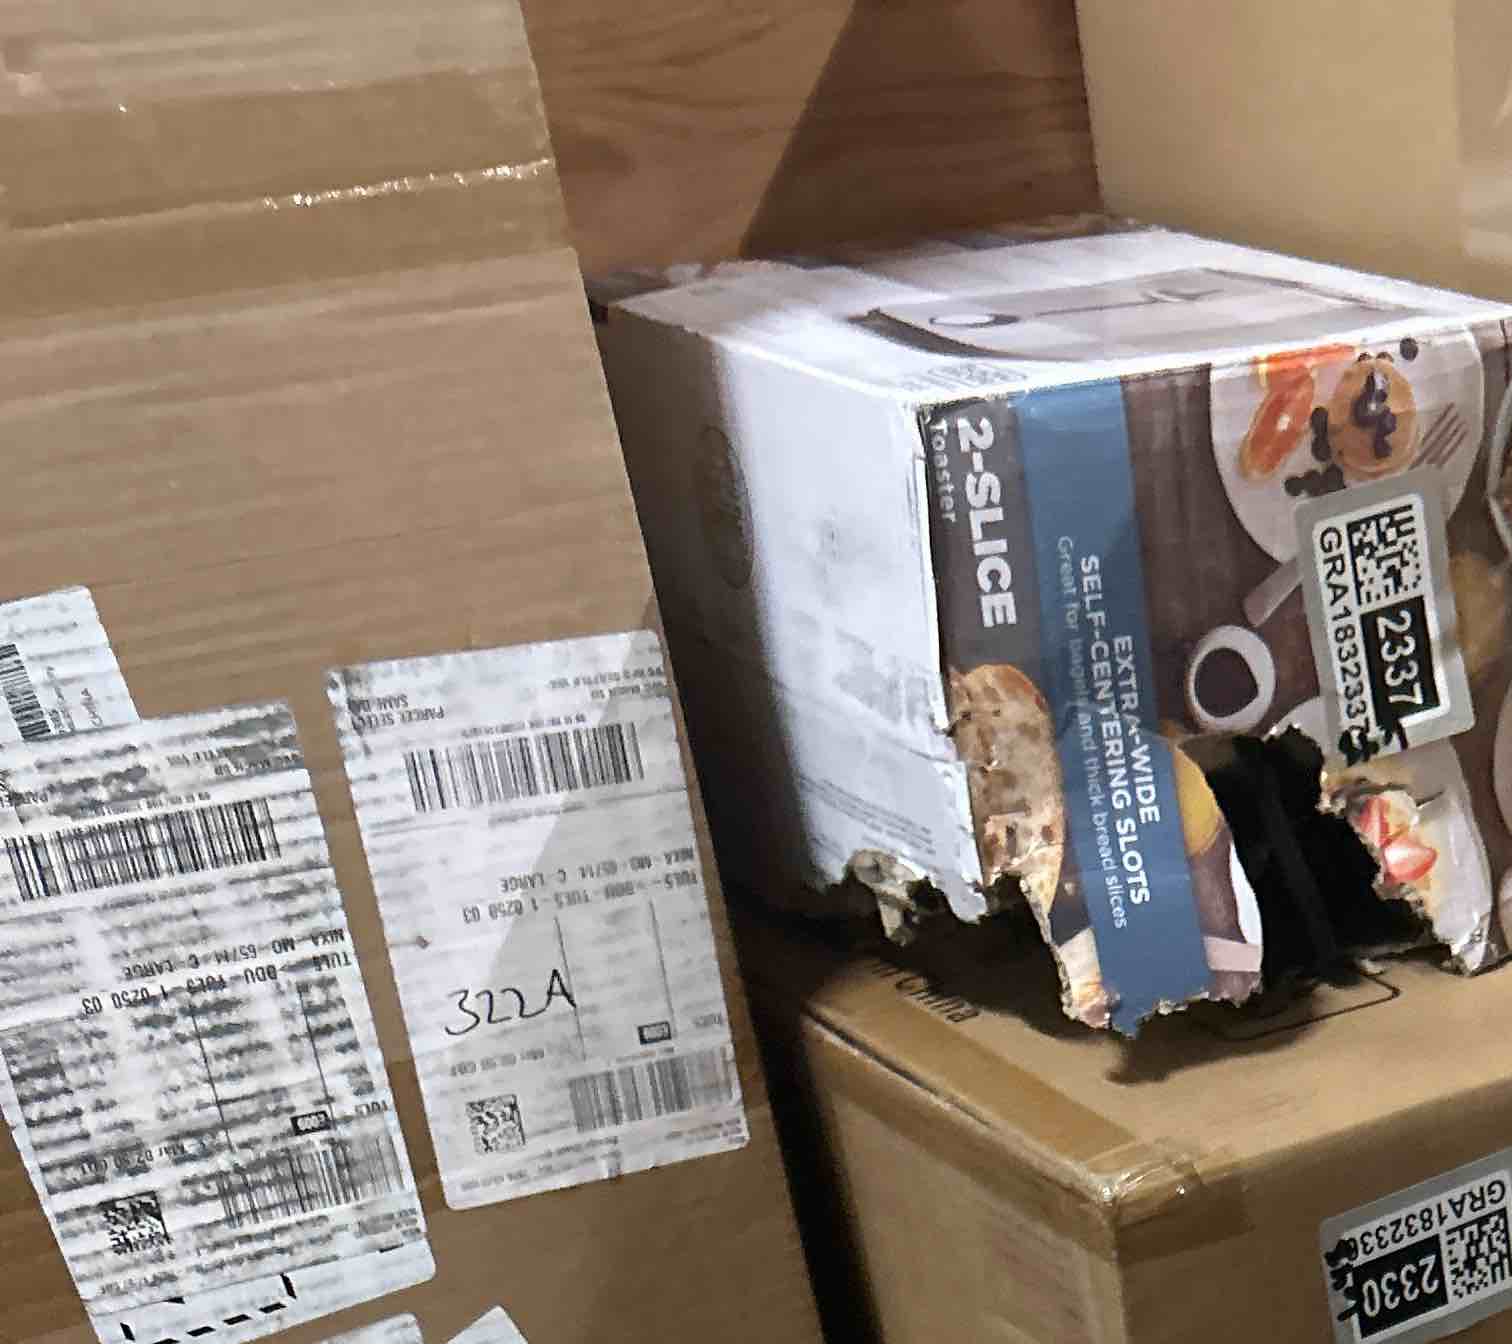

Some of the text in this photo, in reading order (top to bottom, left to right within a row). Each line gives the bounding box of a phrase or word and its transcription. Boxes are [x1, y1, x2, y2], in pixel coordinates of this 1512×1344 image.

[927, 416, 958, 525] Toaster
[957, 416, 1018, 630] 2-SLICE
[1058, 535, 1077, 595] Great
[1375, 609, 1424, 706] 2337
[1078, 712, 1098, 752] and
[1080, 554, 1151, 905] SELF-CENTERING SLOTS
[1112, 635, 1161, 825] EXTRA-WIDE
[1085, 757, 1105, 806] thick
[1091, 812, 1118, 872] bread
[1105, 875, 1128, 929] slices
[444, 968, 577, 1036] 322A
[1362, 1254, 1440, 1318] 2330
